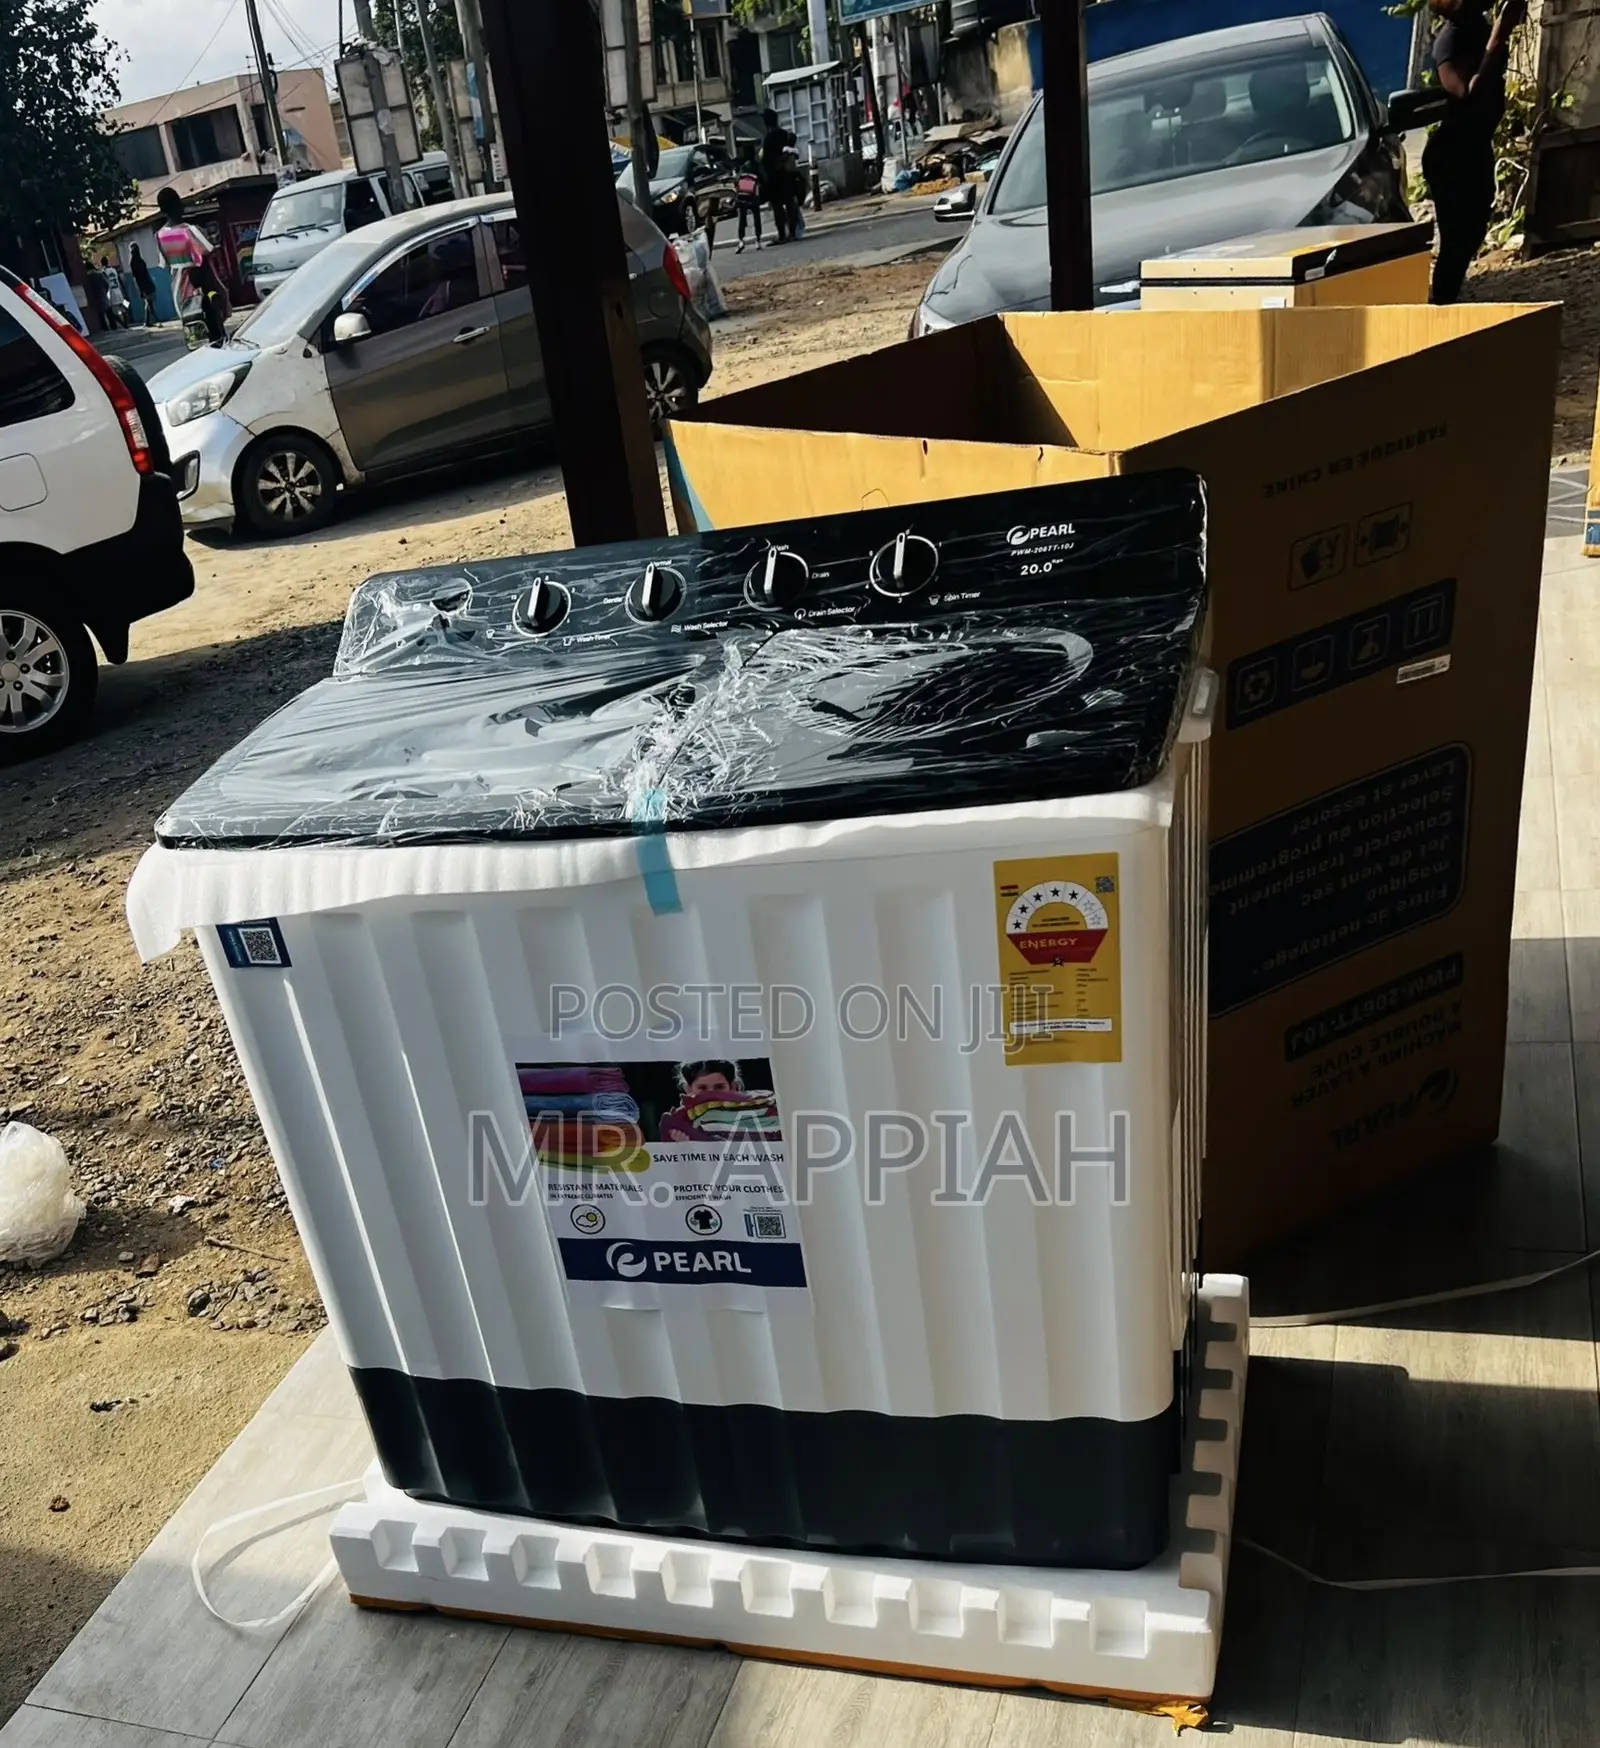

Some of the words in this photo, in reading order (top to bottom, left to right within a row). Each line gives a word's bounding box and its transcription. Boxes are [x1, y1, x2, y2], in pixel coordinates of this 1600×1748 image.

[1357, 420, 1447, 468] FABRIQUE
[1328, 457, 1354, 475] EN
[1261, 467, 1322, 499] CHINE
[1029, 522, 1076, 540] PEARL
[811, 571, 830, 580] Drain
[943, 593, 960, 602] Spin
[960, 591, 981, 600] Timer
[807, 609, 826, 618] Drain
[826, 606, 856, 617] Selector
[683, 622, 702, 631] Wash
[702, 619, 729, 630] Selector
[1400, 758, 1456, 789] Laver
[1372, 783, 1395, 801] et
[1290, 792, 1366, 836] essorer
[1327, 824, 1352, 845] du
[1352, 810, 1453, 858] Couvercle
[1387, 849, 1413, 868] de
[1227, 851, 1346, 917] transparent
[1339, 860, 1384, 891] vent
[1300, 881, 1335, 907] sec
[1019, 937, 1079, 950] ENERGY
[1367, 1005, 1447, 1054] DOUBLE
[1378, 1020, 1463, 1070] MACHINE
[1309, 1044, 1364, 1078] CUVE
[1289, 1069, 1355, 1109] LAVER
[653, 1153, 679, 1163] SAVE
[680, 1152, 706, 1163] TIME
[708, 1153, 720, 1162] IN
[723, 1153, 750, 1163] EACH
[753, 1153, 785, 1163] WASH
[548, 1183, 594, 1193] RESISTANT
[595, 1183, 644, 1193] MATERIALS
[673, 1183, 713, 1194] PROTECT
[715, 1184, 742, 1194] YOUR
[743, 1184, 785, 1195] CLOTHES
[653, 1251, 752, 1274] PEARL
